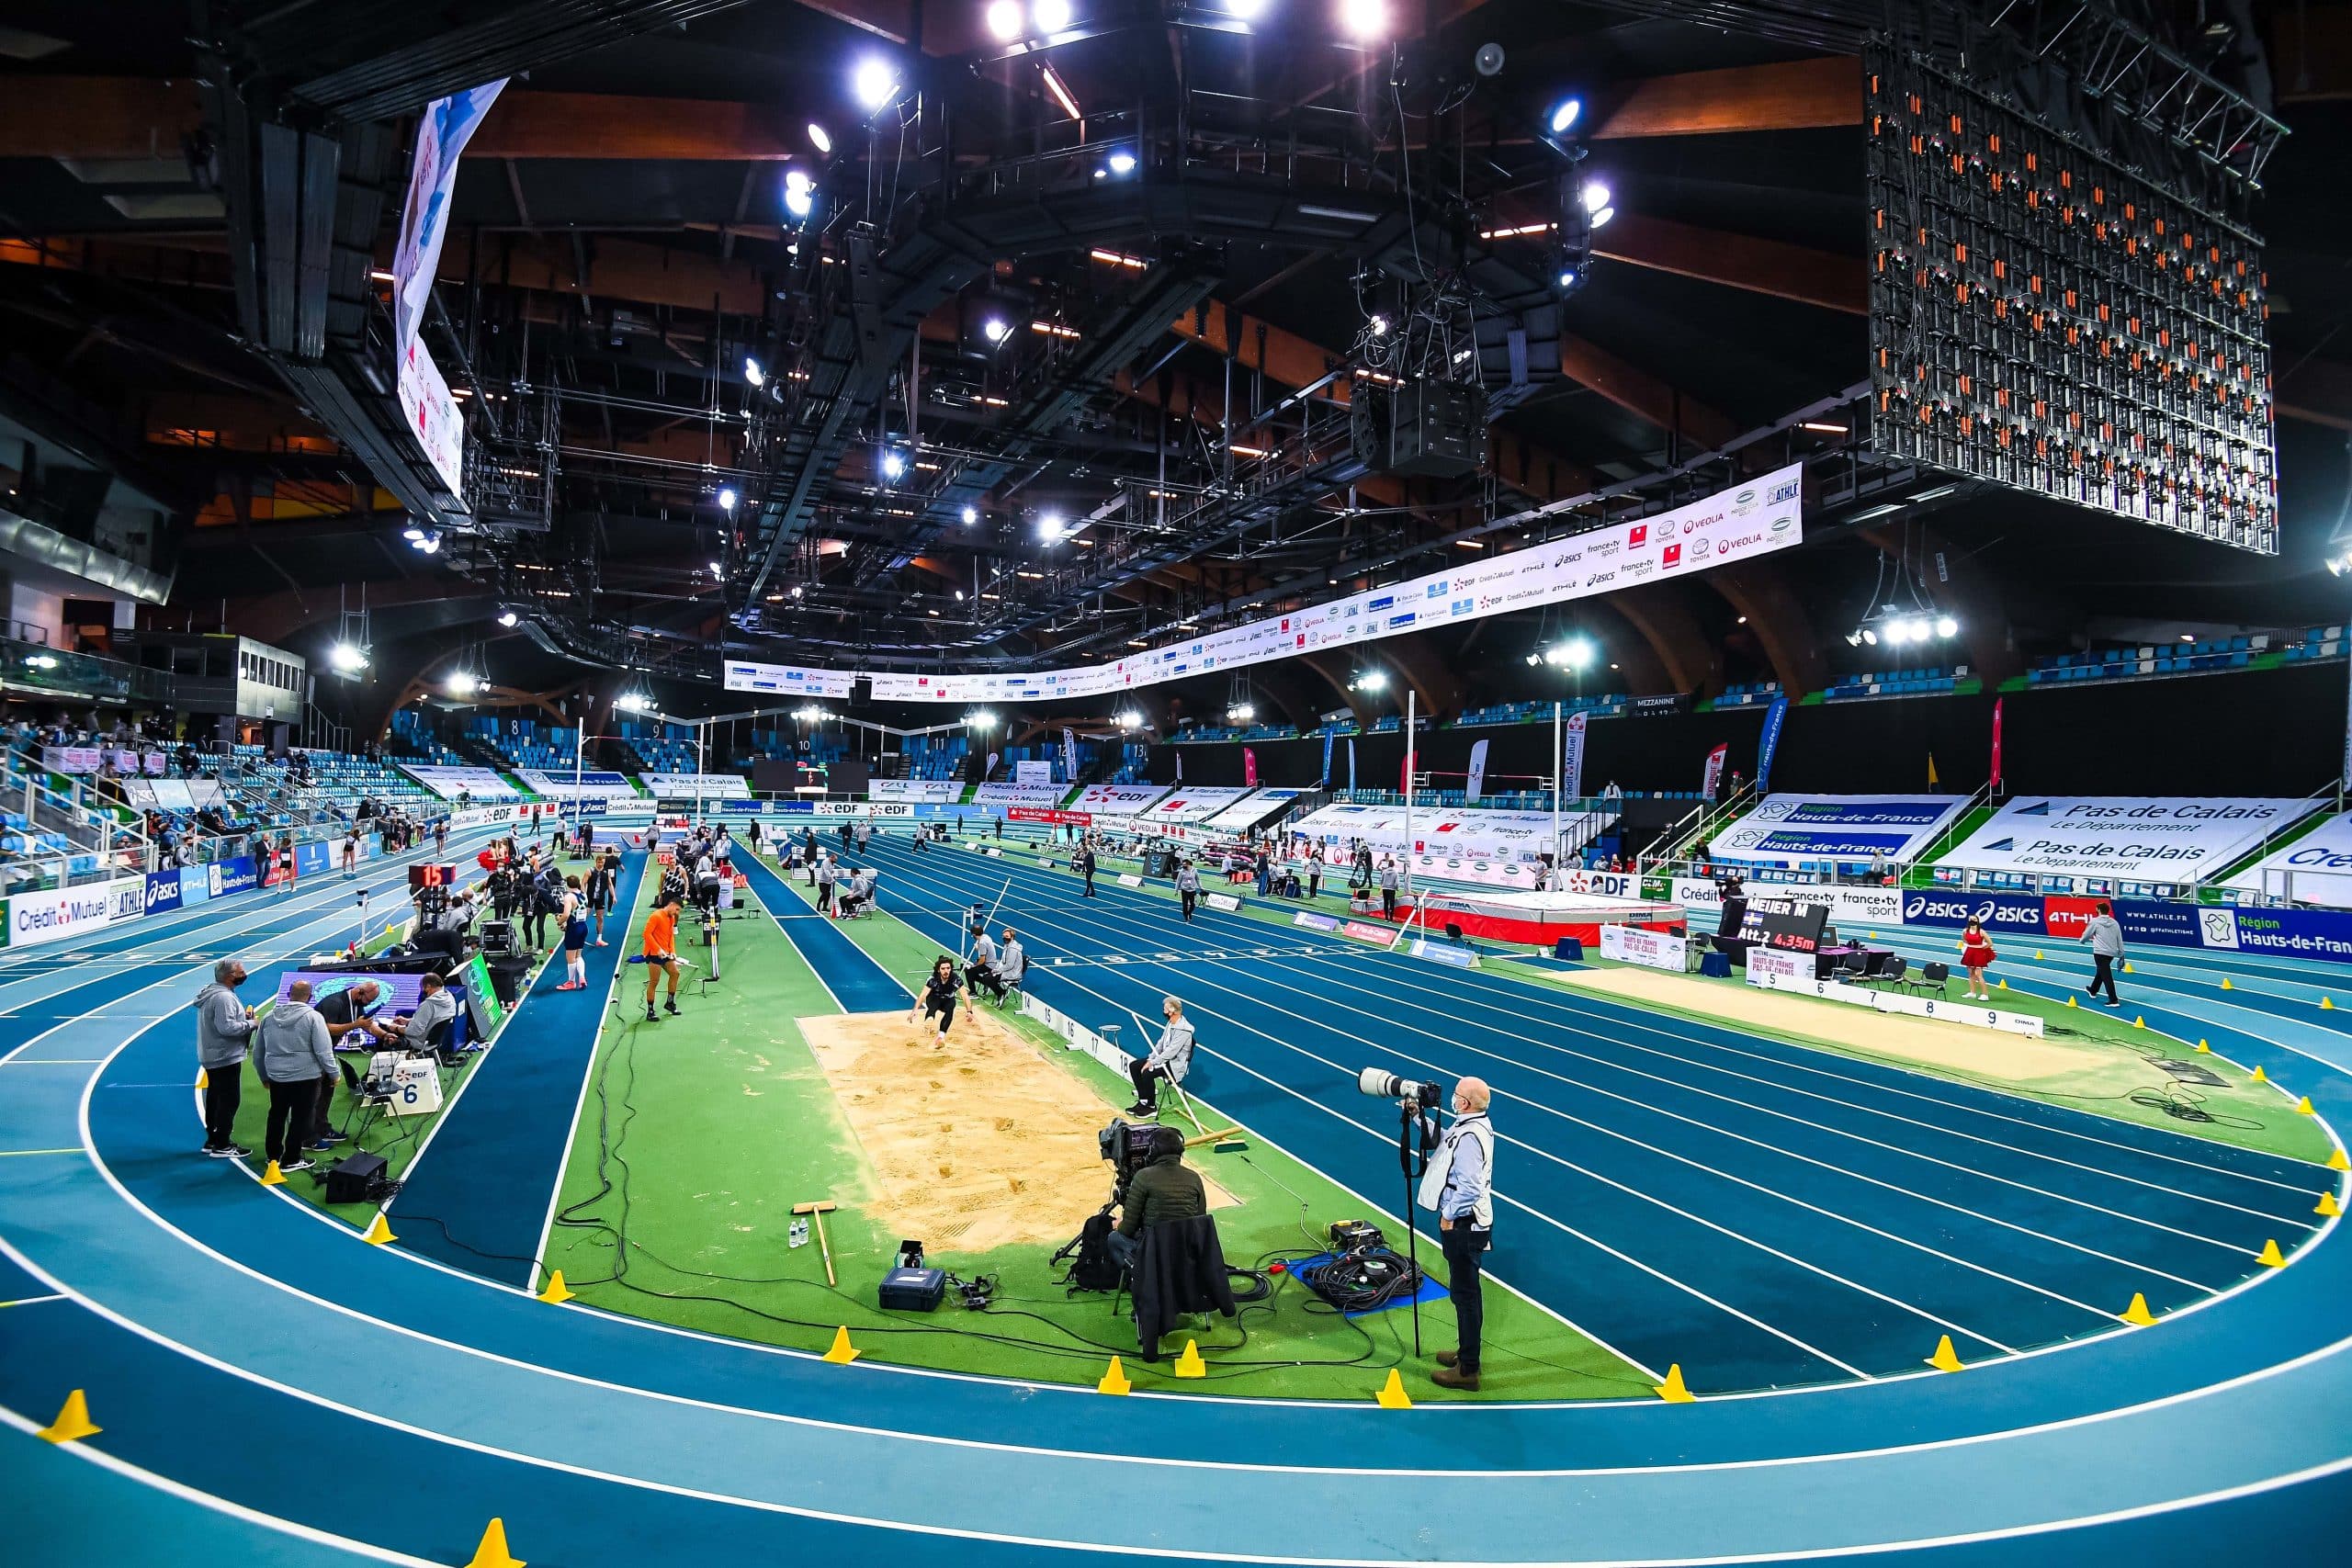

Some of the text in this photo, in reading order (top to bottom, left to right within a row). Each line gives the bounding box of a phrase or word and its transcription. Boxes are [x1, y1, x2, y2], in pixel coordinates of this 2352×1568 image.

[1776, 483, 1799, 502] ATHLE
[1696, 513, 1724, 528] VEOLIA
[1656, 535, 1675, 544] TOYOTA
[1731, 534, 1762, 548] VEOLIA
[1690, 553, 1710, 563] TOYOTA
[1637, 698, 1675, 706] MEZZANINE
[412, 713, 419, 728] 7
[511, 720, 518, 735] 8
[653, 725, 660, 739] 9
[1764, 705, 1783, 766] Hauts-de-France
[799, 740, 810, 750] 10
[934, 738, 944, 750] 11
[1135, 744, 1143, 757] 13
[1566, 736, 1577, 764] Mutuel
[1801, 804, 1843, 813] Région
[1790, 813, 1933, 823] Hauts-de-France
[2050, 820, 2201, 831] Le Département
[1770, 833, 1811, 841] Région
[1760, 840, 1894, 853] Hauts-de-France
[2013, 854, 2034, 863] Le
[424, 865, 441, 886] 15
[158, 881, 178, 900] asics
[1681, 887, 1718, 902] Crédit
[119, 889, 142, 914] ATHLE
[1747, 898, 1808, 918] MEIJER M
[18, 897, 107, 931] Crédit Mutuel
[1867, 906, 1897, 918] sport
[1926, 903, 1967, 918] asics
[1996, 906, 2039, 923] asics
[2126, 912, 2187, 921] WWW.ATHLE.FR
[2238, 917, 2279, 929] Région
[1737, 928, 1815, 950] Att.2 4.35m
[1770, 975, 1775, 984] 5
[1817, 983, 1824, 994] 6
[1024, 998, 1030, 1010] 14
[1870, 992, 1877, 1002] 7
[1926, 1002, 1933, 1013] 8
[1045, 1008, 1051, 1022] 15
[1988, 1011, 1996, 1023] 9
[1068, 1021, 1074, 1037] 16
[1091, 1036, 1099, 1053] 17
[1120, 1055, 1128, 1074] 18
[404, 1084, 417, 1103] 6
